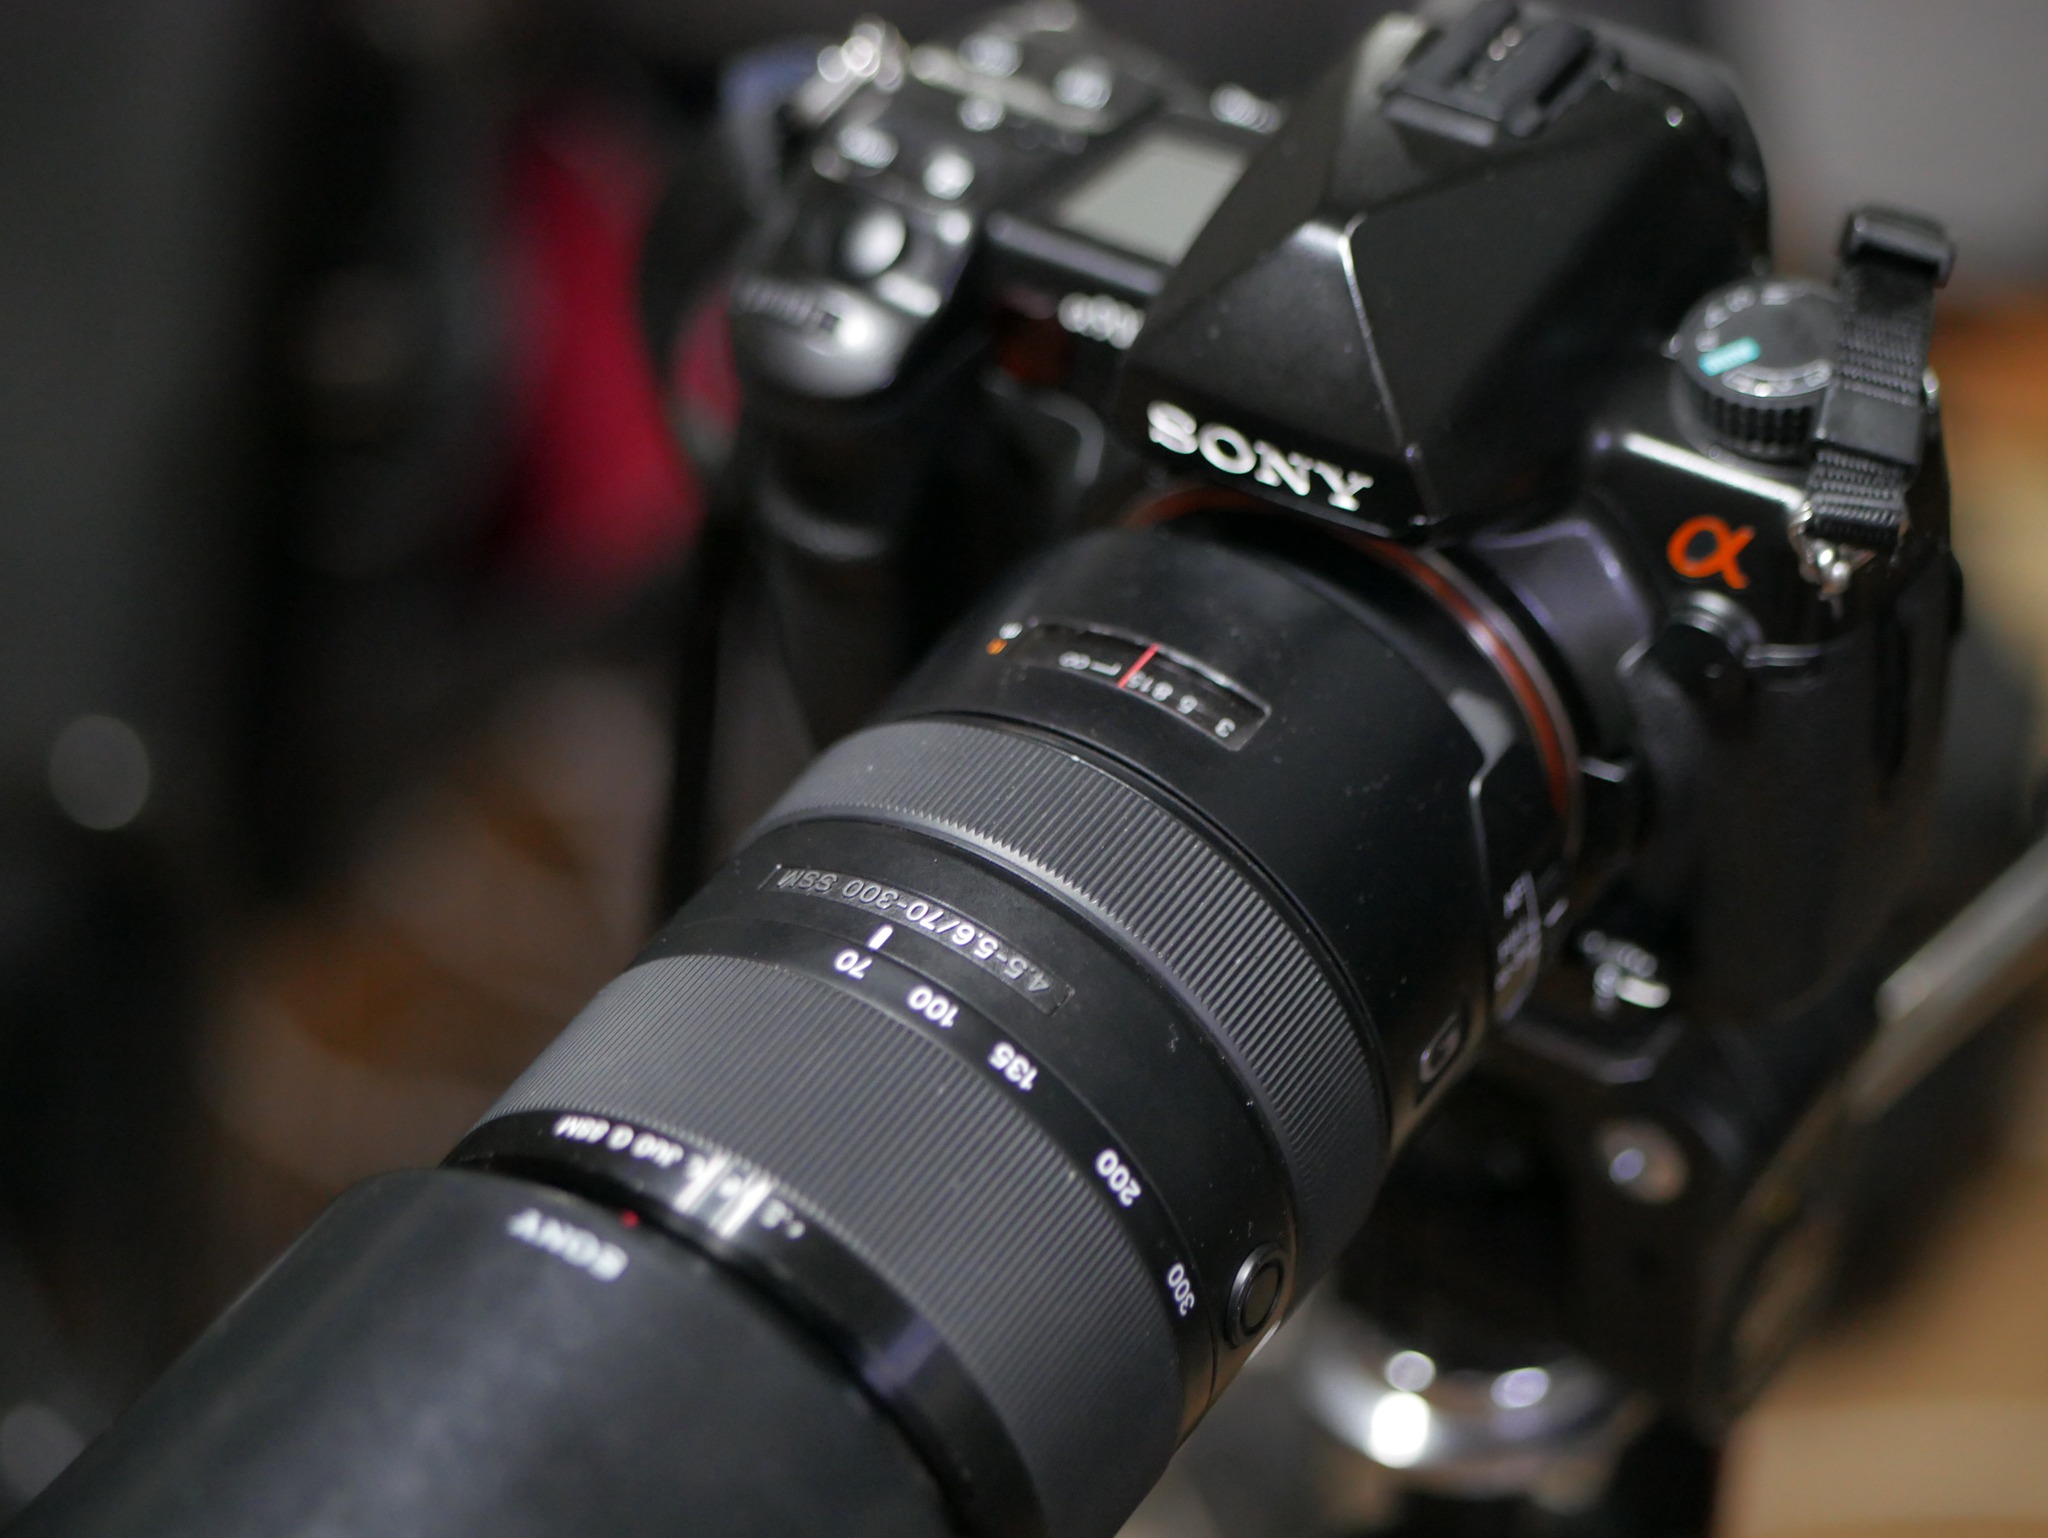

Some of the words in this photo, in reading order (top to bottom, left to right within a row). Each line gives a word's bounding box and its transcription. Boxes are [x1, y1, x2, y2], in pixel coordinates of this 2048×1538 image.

[1146, 401, 1374, 512] SONY
[776, 866, 839, 893] SSM
[841, 878, 1050, 993] 4.5-5.6/70-300
[833, 947, 873, 981] 70
[907, 984, 961, 1029] 100
[987, 1040, 1039, 1092] 135
[1094, 1148, 1142, 1208] 200
[1166, 1261, 1195, 1317] 300
